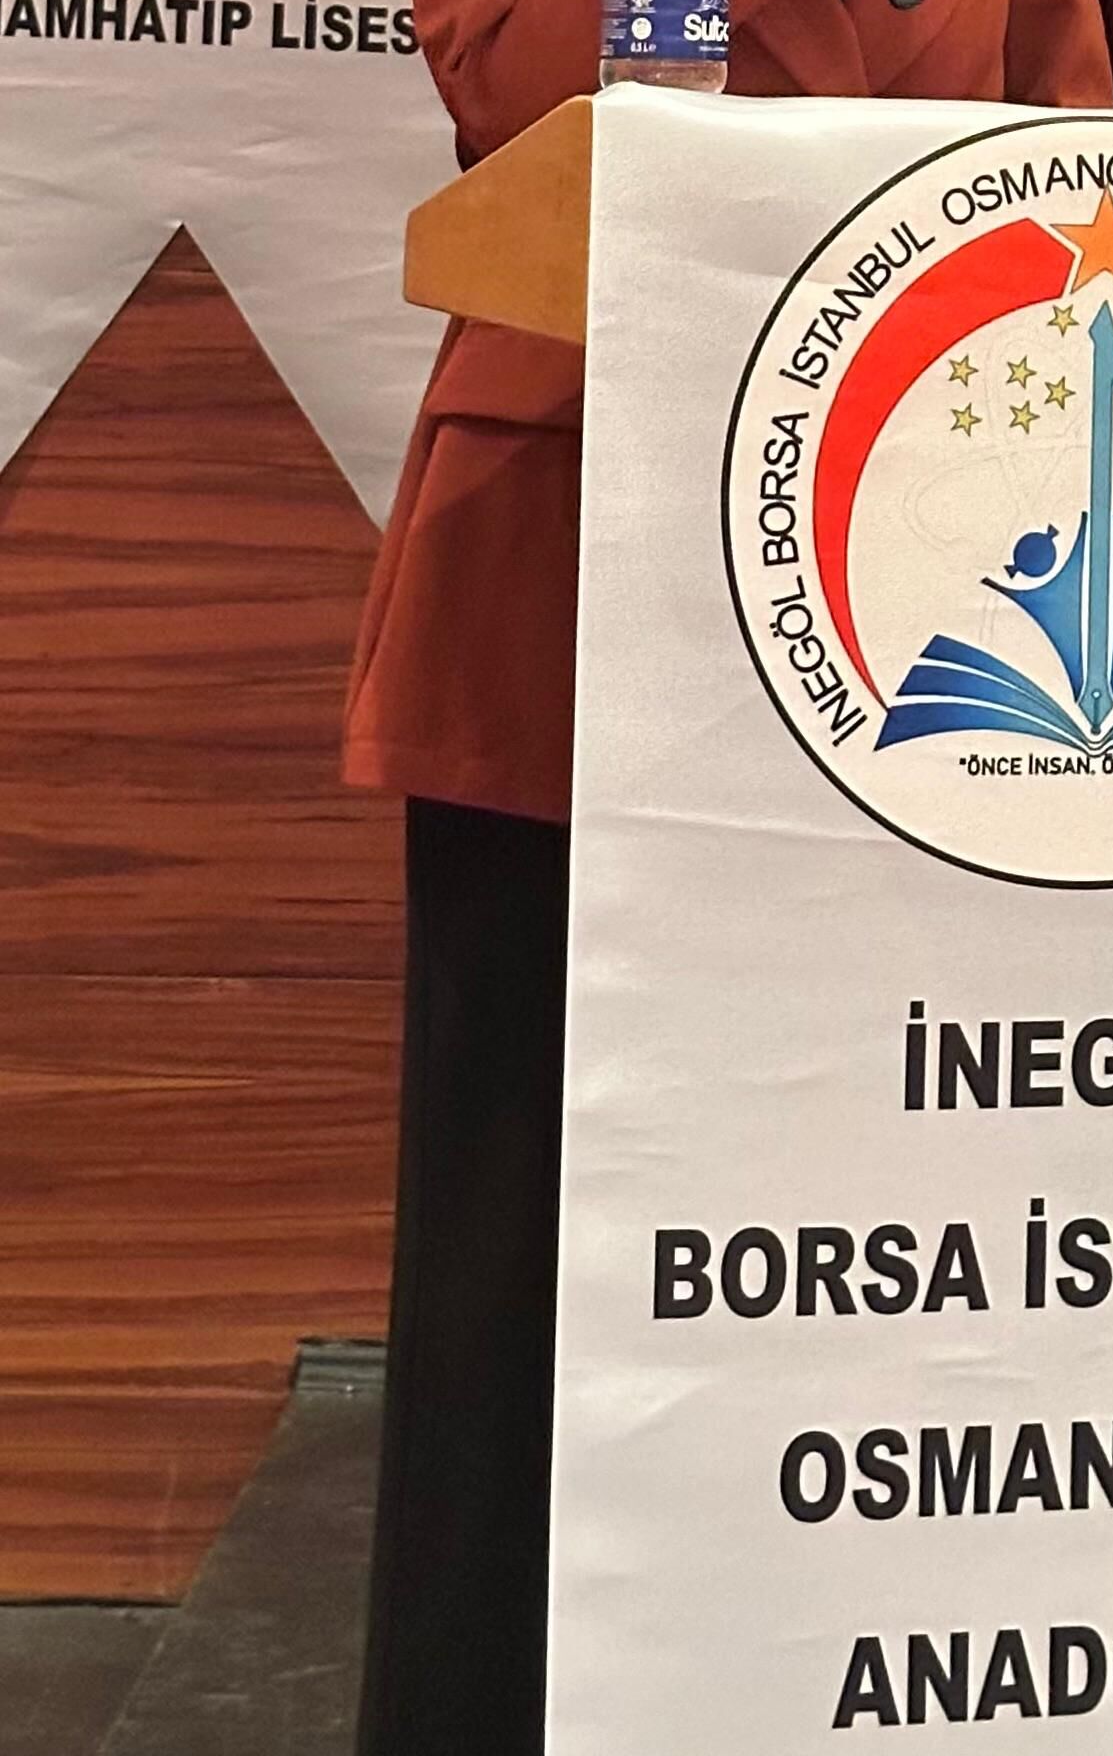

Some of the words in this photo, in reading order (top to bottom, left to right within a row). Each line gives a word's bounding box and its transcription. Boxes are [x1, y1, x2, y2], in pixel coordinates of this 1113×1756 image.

[779, 220, 936, 389] İSTANBUL
[759, 412, 809, 566] BORSA
[769, 575, 867, 747] İNEGÖL
[959, 753, 1022, 776] "ÖNCE
[652, 1222, 989, 1320] BORSA
